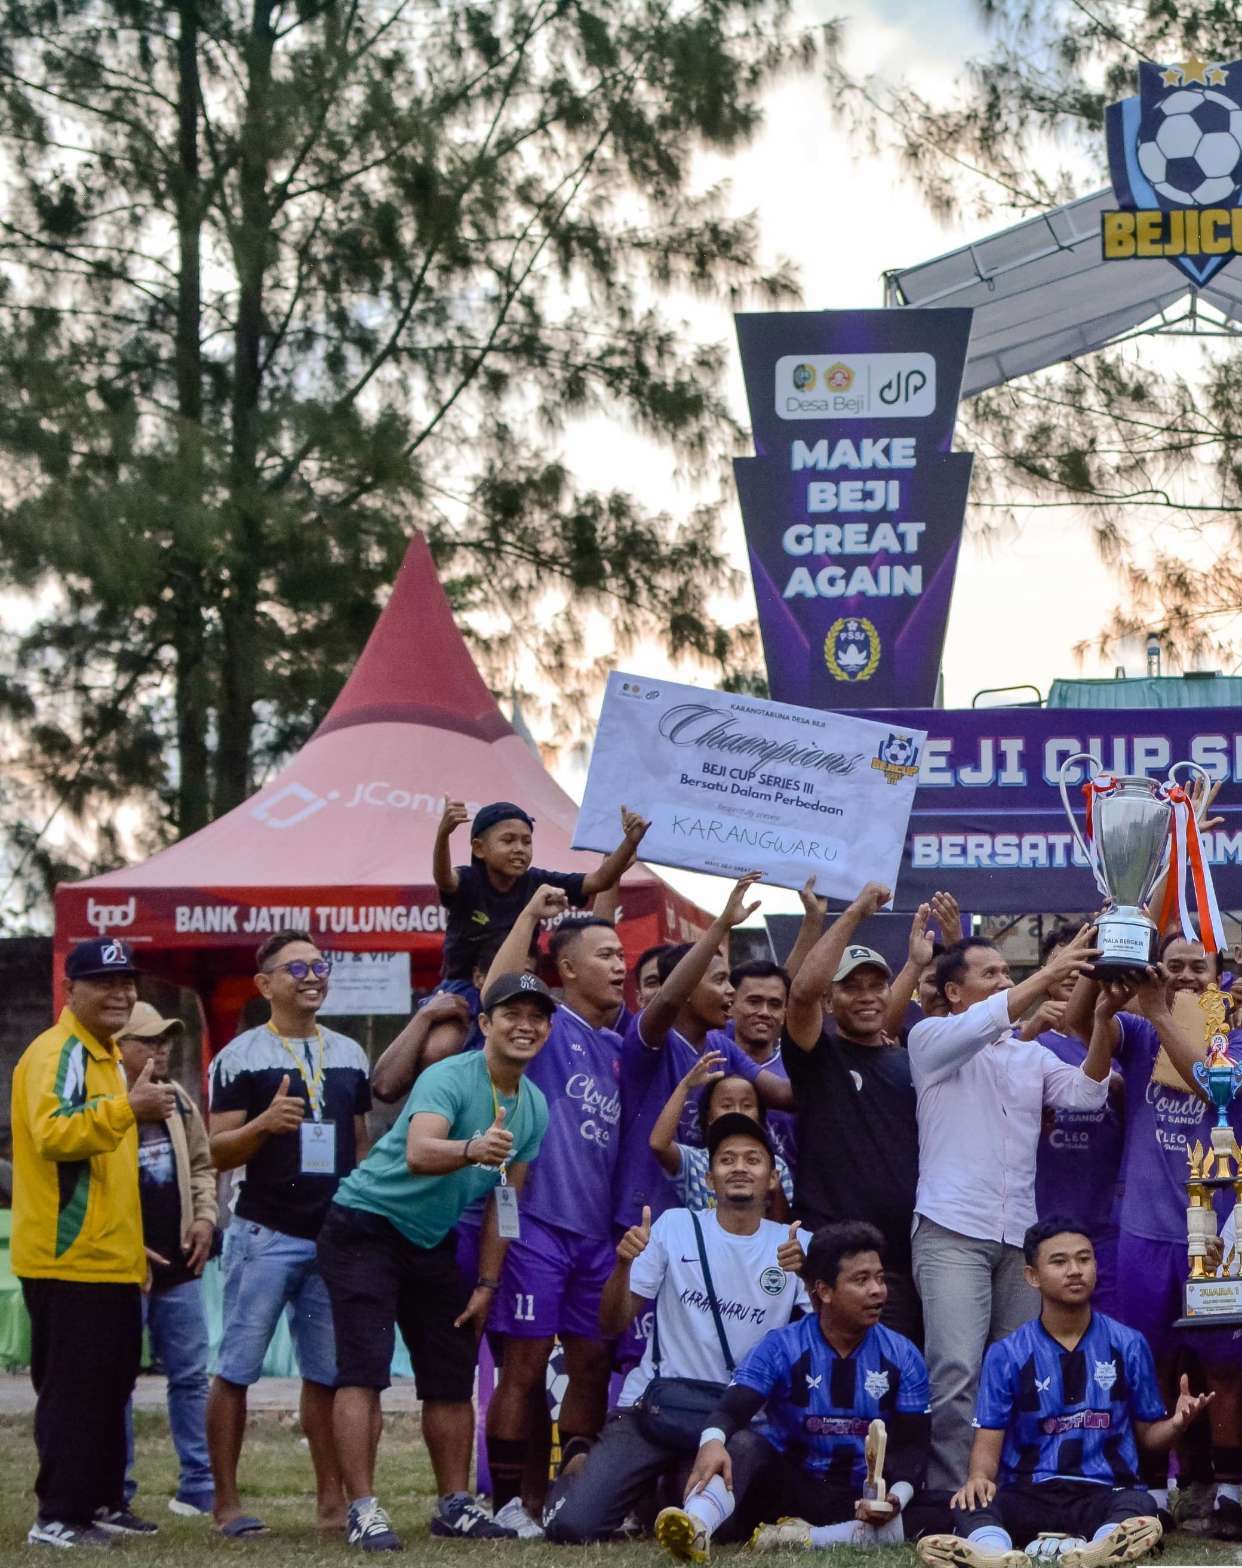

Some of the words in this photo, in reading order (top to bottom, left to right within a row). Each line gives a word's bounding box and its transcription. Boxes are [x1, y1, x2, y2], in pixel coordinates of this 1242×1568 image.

[786, 397, 828, 412] Desa
[833, 395, 865, 414] Beji
[791, 437, 917, 471] MAKE
[806, 480, 900, 513] BEJI
[782, 522, 926, 556] GREAT
[783, 565, 923, 599] AGAIN
[840, 631, 865, 641] PSSI
[730, 703, 790, 721] KARANGTARUNA
[792, 715, 810, 725] DESA
[812, 720, 826, 728] BEJI
[659, 704, 864, 776] Champions
[702, 762, 726, 777] BEJI
[729, 768, 756, 782] CUP
[758, 774, 800, 791] SERIES
[803, 782, 815, 795] III
[919, 738, 1027, 787] EJI
[680, 773, 728, 793] Bersatu
[731, 783, 772, 802] Dalam
[774, 792, 844, 817] Perbedaan
[672, 815, 838, 861] KARANGWARU
[175, 905, 239, 933] BANK
[243, 905, 311, 933] JATIM
[316, 905, 449, 933] TULUNGAGU
[1146, 1081, 1208, 1125] Coudy
[1049, 1129, 1089, 1149] CLEO
[513, 1293, 536, 1322] 11
[680, 1288, 750, 1321] KARAGWARU
[750, 1307, 767, 1325] FC
